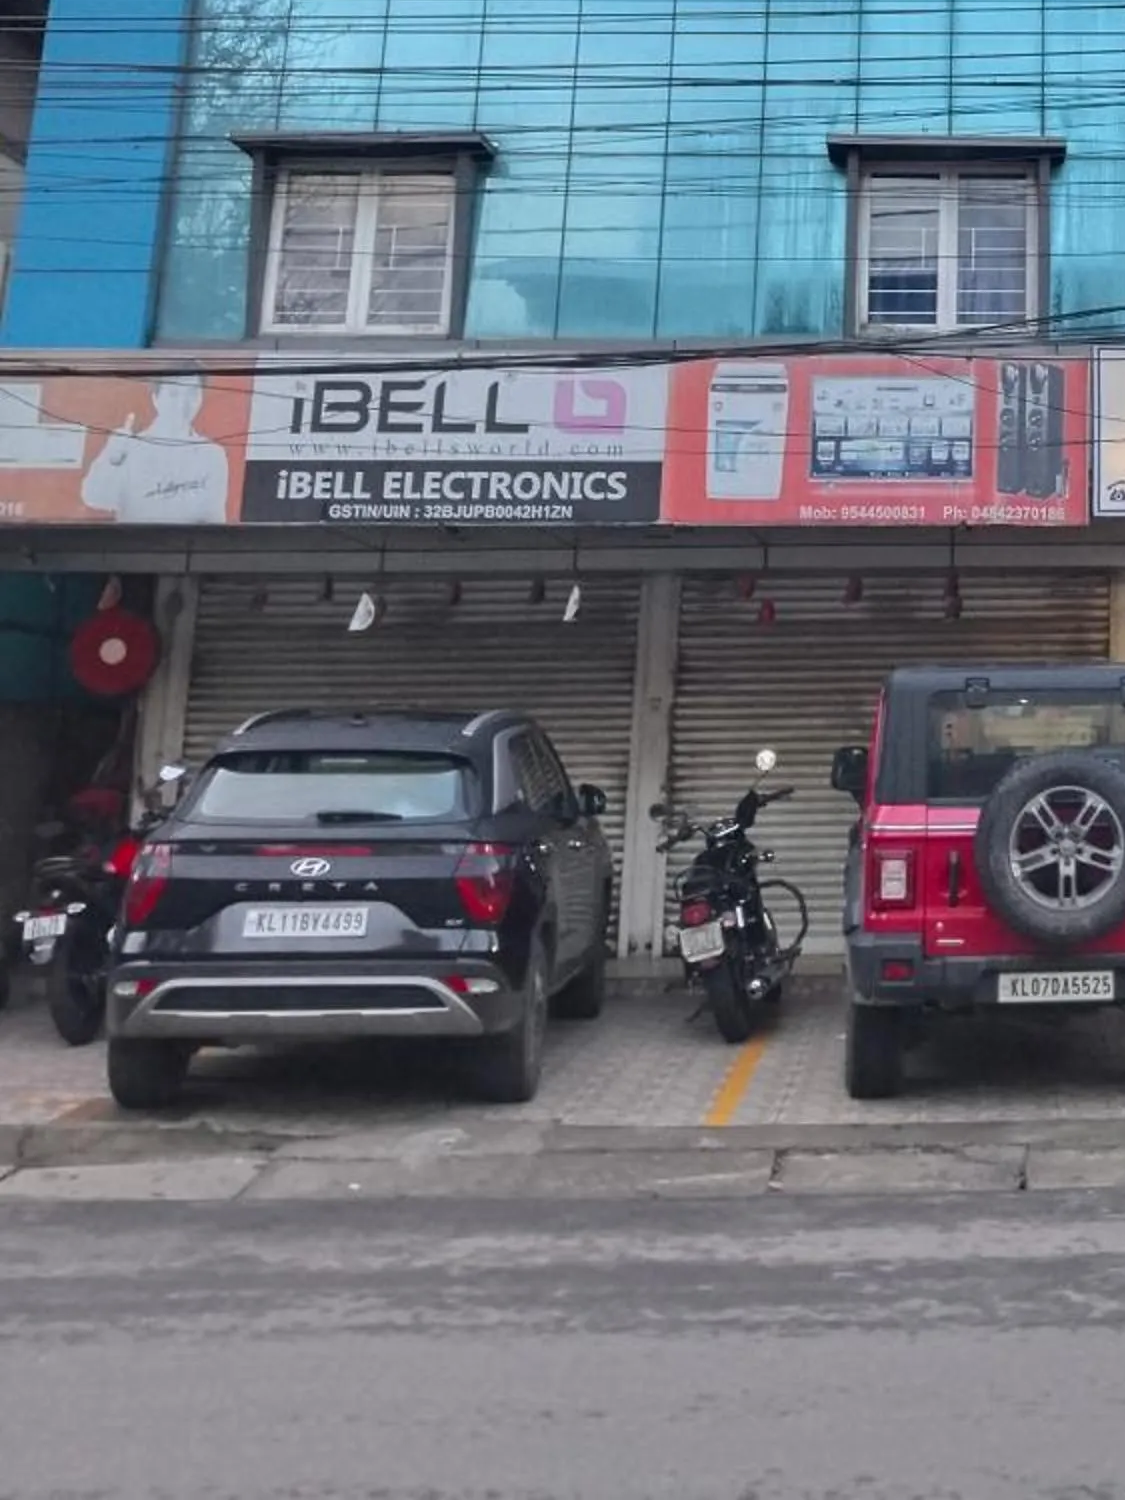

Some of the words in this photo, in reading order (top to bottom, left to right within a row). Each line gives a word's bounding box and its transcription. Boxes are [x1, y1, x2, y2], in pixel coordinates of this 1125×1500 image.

[290, 379, 529, 434] iBELL
[276, 470, 371, 501] iBELL
[382, 471, 627, 501] ELECTRONICS
[328, 504, 410, 519] GSTIN/UIN
[800, 507, 837, 520] Mob:
[234, 881, 379, 892] CRETA
